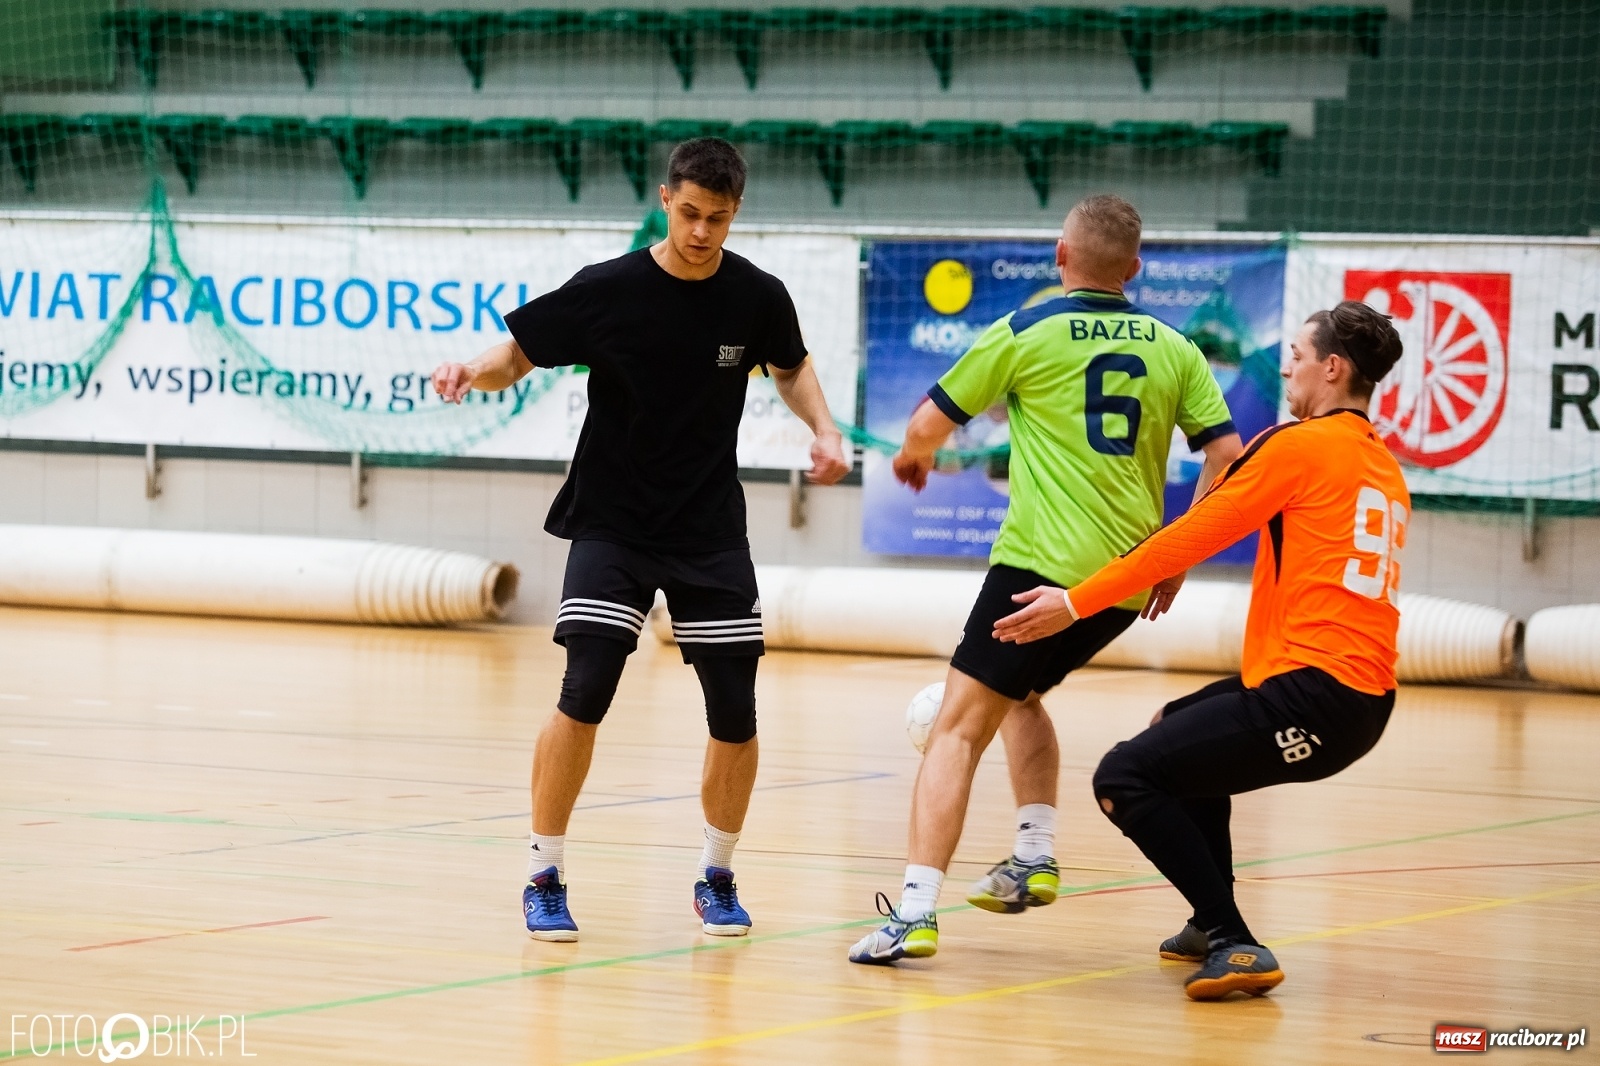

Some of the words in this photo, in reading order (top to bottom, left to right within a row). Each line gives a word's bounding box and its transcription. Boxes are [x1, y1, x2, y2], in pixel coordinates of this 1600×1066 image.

[142, 274, 527, 333] RACIBORSKI
[1070, 319, 1156, 343] BAZEJ
[127, 357, 373, 409] wspieramy,
[1084, 353, 1147, 456] 6
[1275, 726, 1313, 763] 98
